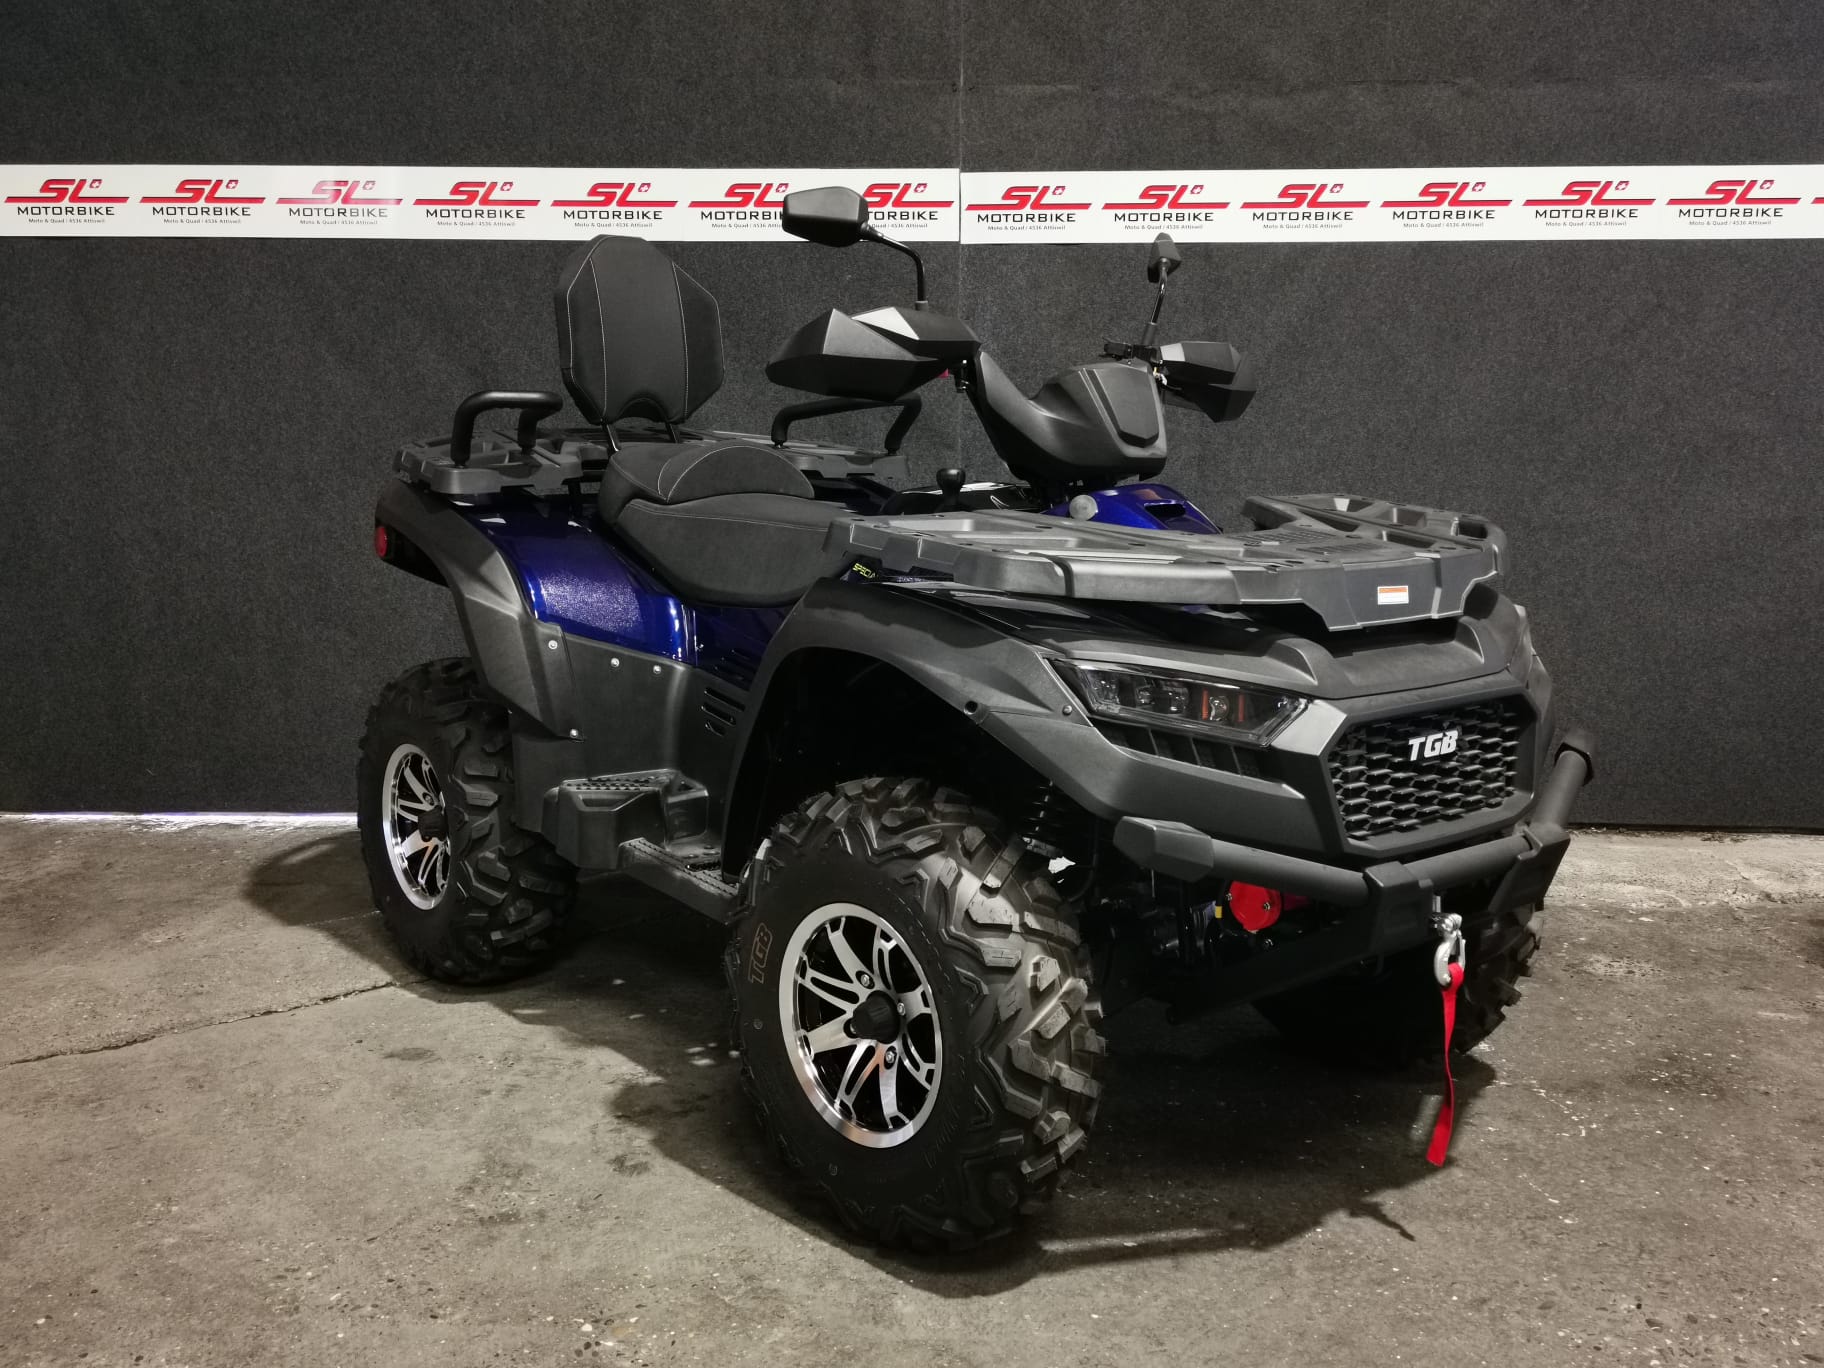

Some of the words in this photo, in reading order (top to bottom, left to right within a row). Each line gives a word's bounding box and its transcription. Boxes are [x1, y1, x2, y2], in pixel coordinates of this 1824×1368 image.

[4, 179, 129, 204] SL
[140, 179, 265, 204] SL
[276, 180, 402, 206] SL
[413, 182, 540, 207] SL
[551, 183, 677, 208] SL
[688, 183, 785, 208] SL
[863, 183, 953, 208] SL
[965, 186, 1091, 211] SL
[1103, 185, 1229, 210] SL
[1241, 184, 1369, 209] SL
[1381, 182, 1511, 208] SL
[1523, 181, 1655, 206] SL
[1667, 180, 1800, 206] SL
[17, 206, 115, 216] MOTORBIKE
[152, 206, 251, 217] MOTORBIKE
[288, 207, 388, 218] MOTORBIKE
[426, 208, 526, 219] MOTORBIKE
[563, 210, 663, 220] MOTORBIKE
[700, 210, 784, 220] MOTORBI
[868, 210, 938, 221] TORBIKE
[977, 213, 1076, 223] MOTORBIKE
[1114, 212, 1214, 222] MOTORBIKE
[1252, 211, 1353, 221] MOTORBIKE
[1392, 209, 1495, 220] MOTORBIKE
[1535, 208, 1638, 219] MOTORBIKE
[1678, 207, 1783, 218] MOTORBIKE
[1408, 730, 1458, 761] TGB
[748, 922, 772, 984] TGB
